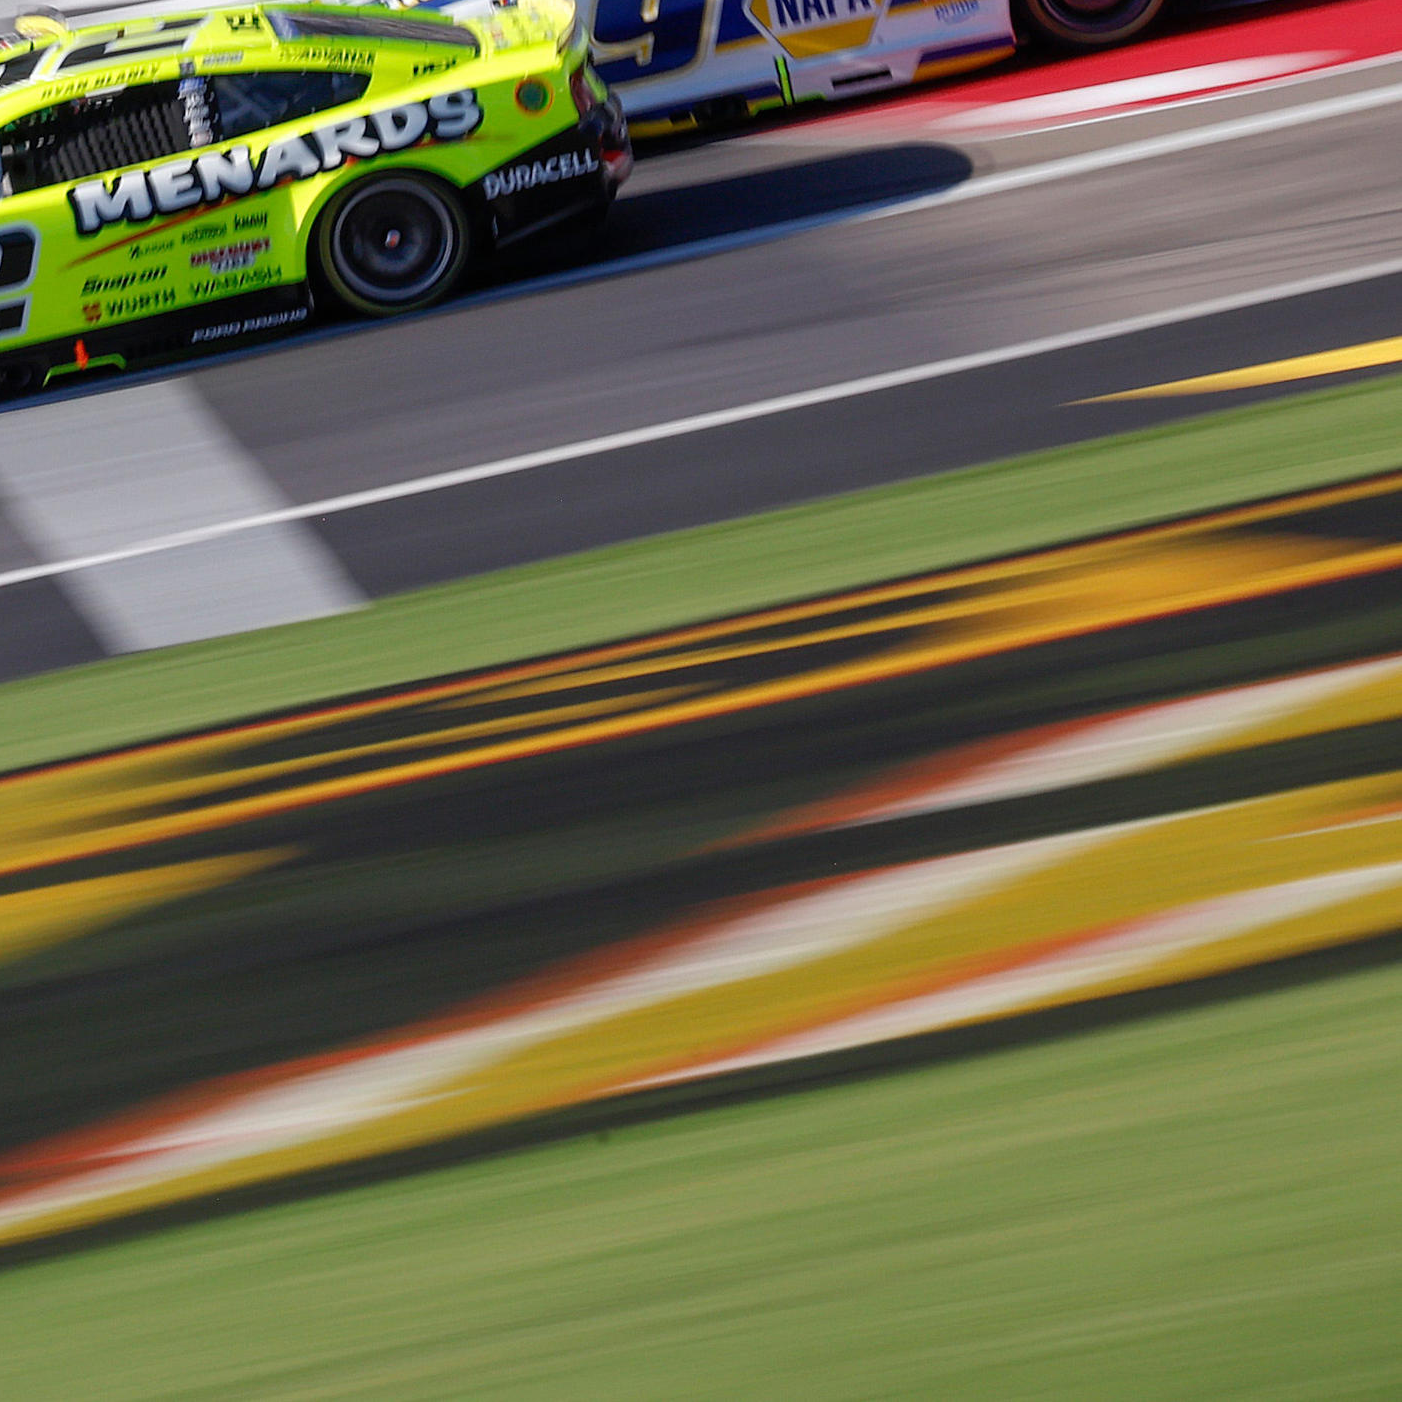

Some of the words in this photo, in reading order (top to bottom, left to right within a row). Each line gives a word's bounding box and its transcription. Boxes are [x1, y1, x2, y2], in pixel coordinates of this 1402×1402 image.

[41, 80, 88, 101] RYAN
[93, 63, 159, 88] BLANEY
[71, 88, 482, 232] MENARDS
[482, 148, 601, 201] DURACELL
